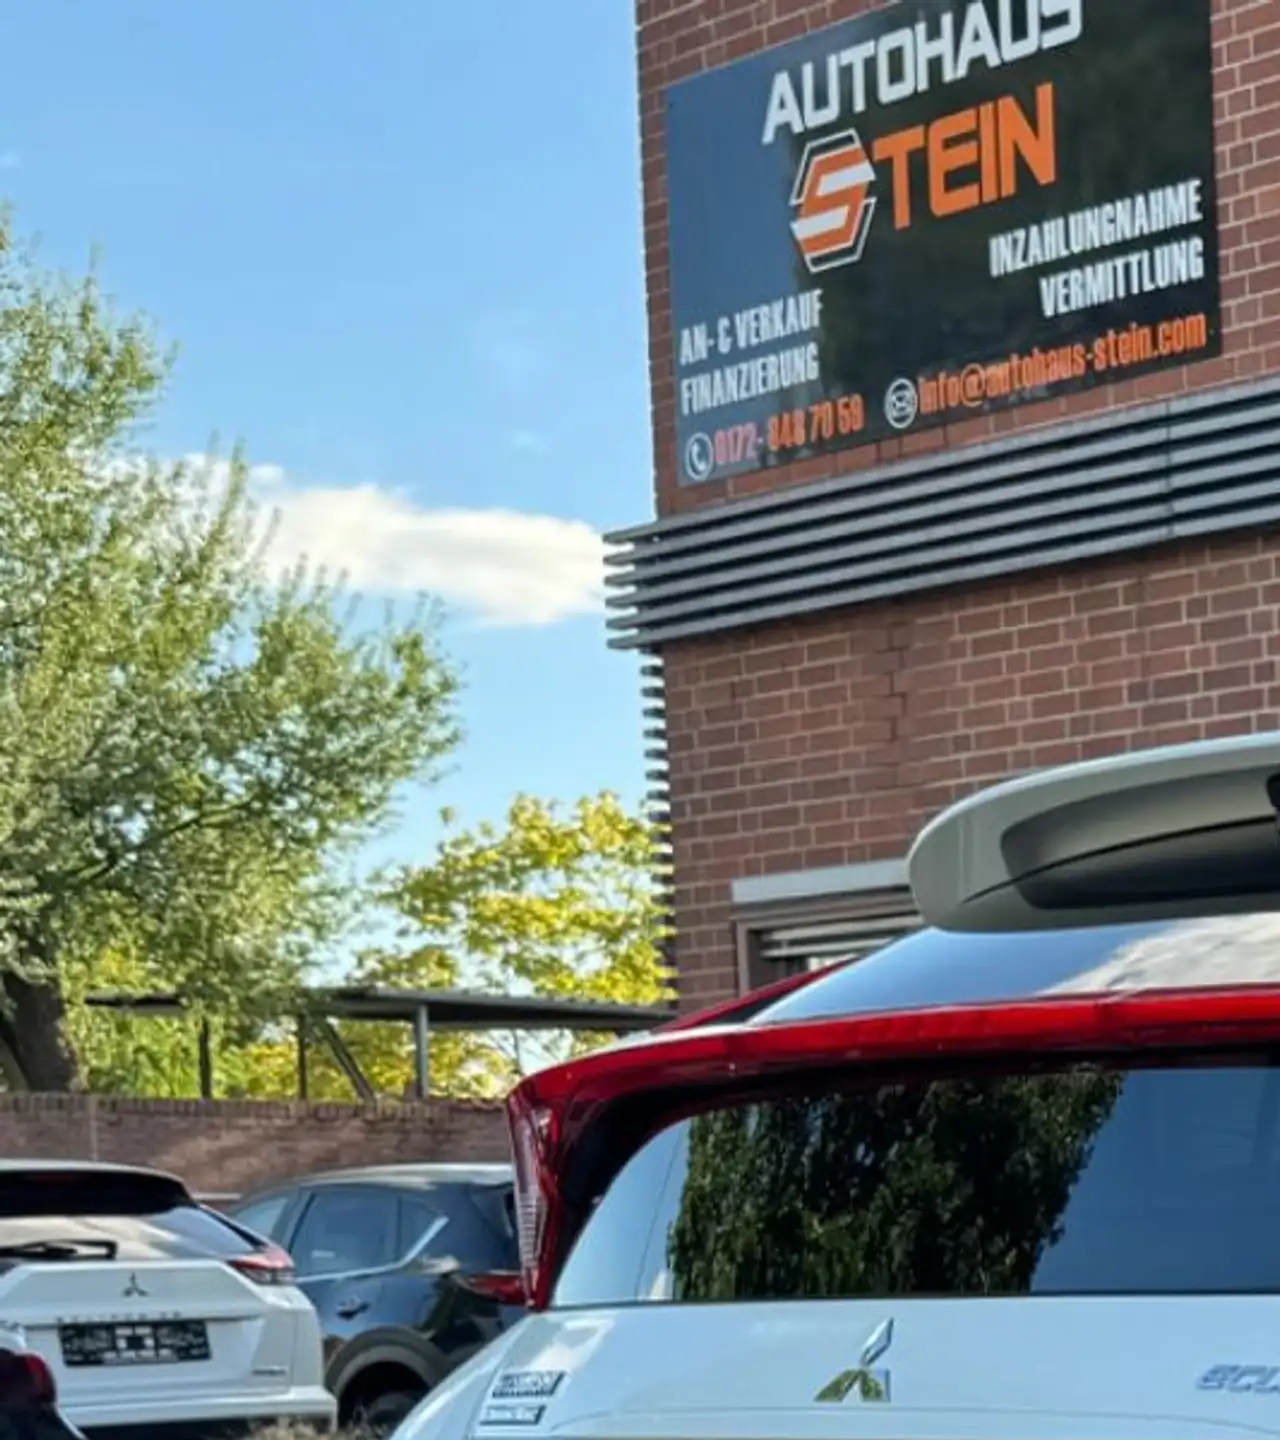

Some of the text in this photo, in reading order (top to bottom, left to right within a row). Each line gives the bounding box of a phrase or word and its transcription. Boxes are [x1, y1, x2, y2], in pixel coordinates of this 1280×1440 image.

[762, 0, 1082, 144] AUTOHAUS
[790, 81, 1056, 273] STEIN
[989, 178, 1203, 278] INZAHLUNGNAHME
[1039, 236, 1204, 318] VERMITTLUNG
[680, 324, 715, 366] AN-
[735, 288, 823, 348] VERKAUF
[918, 312, 1206, 414] info@autohaus-stein.com
[681, 342, 820, 416] FINANZIERUNG
